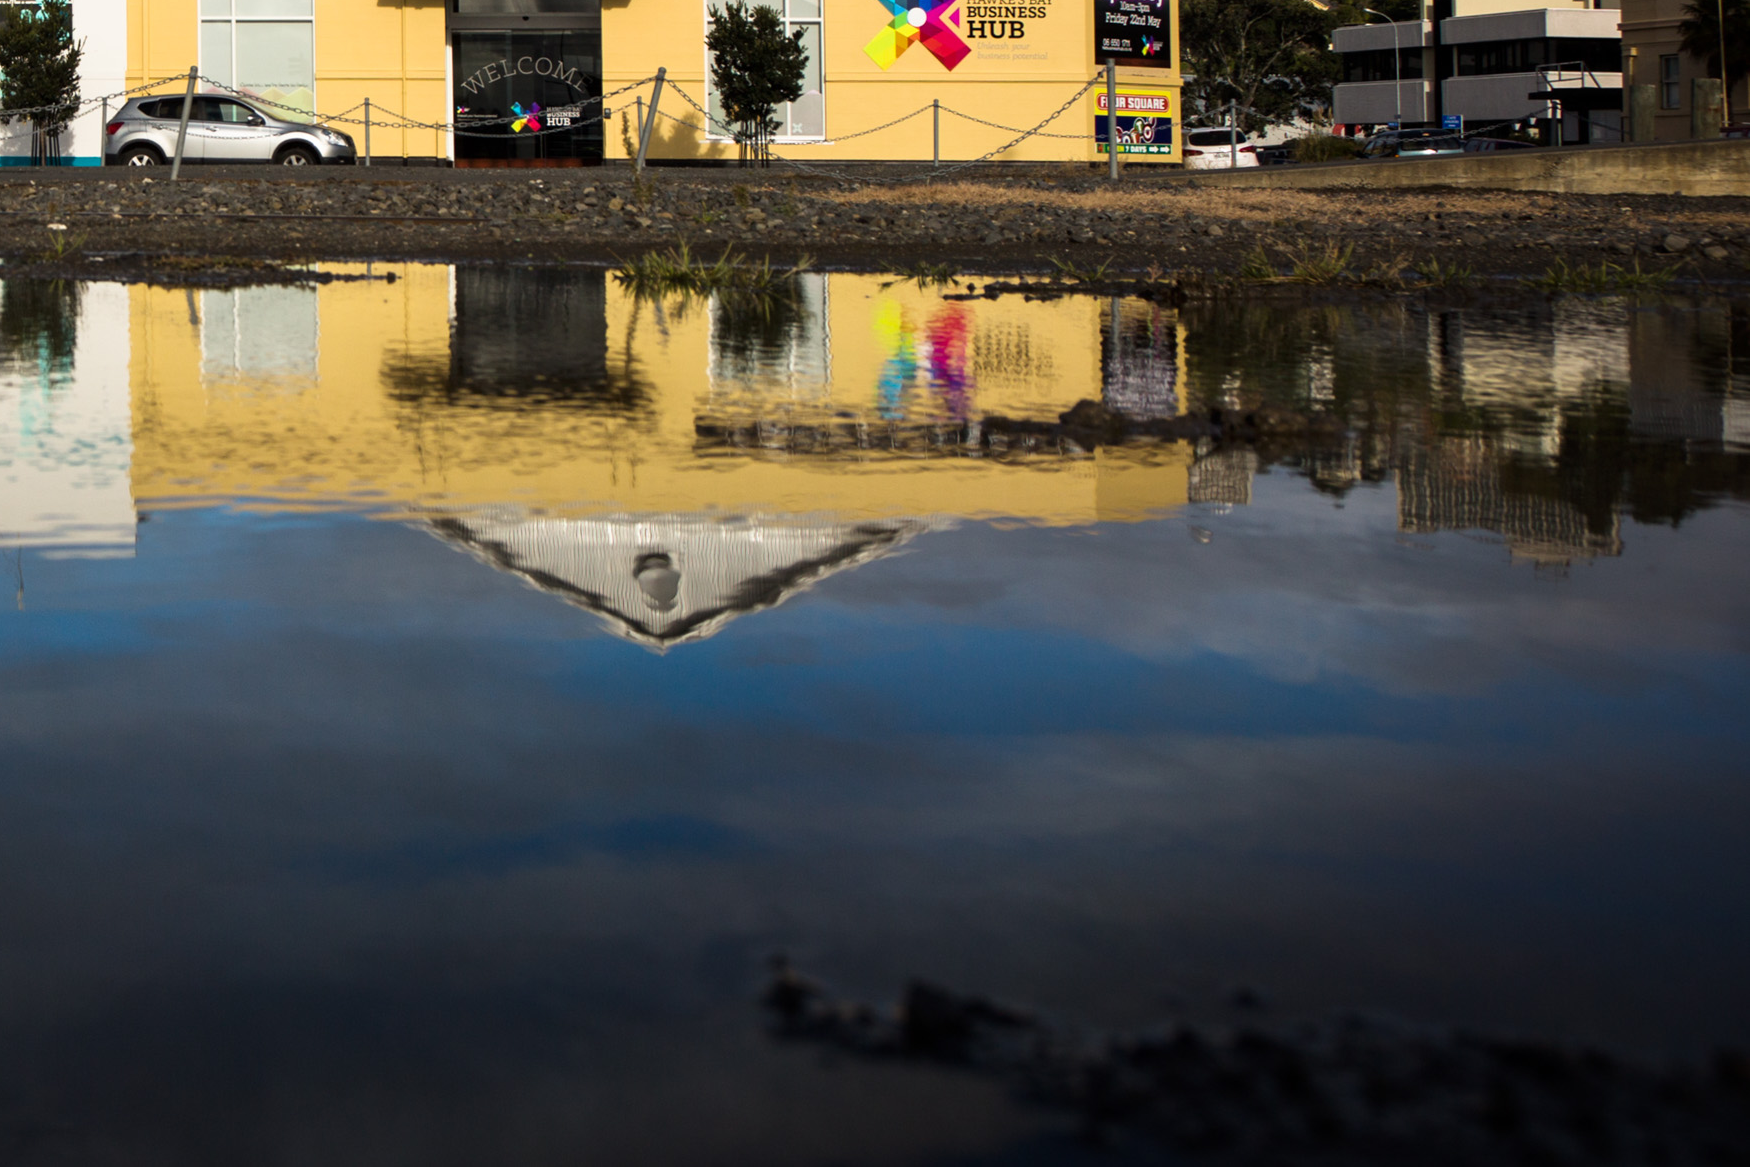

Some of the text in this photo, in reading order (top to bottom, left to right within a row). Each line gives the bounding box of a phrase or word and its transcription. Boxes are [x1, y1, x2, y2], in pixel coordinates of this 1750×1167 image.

[966, 6, 1046, 18] BUSINESS
[1105, 12, 1161, 28] Friday 22nd May
[967, 20, 1025, 39] HUB
[1012, 52, 1048, 61] potential
[460, 56, 593, 94] WELCOME
[1100, 96, 1165, 110] FUR SQUARE
[546, 117, 571, 126] HUB
[1130, 145, 1147, 153] DAYS
